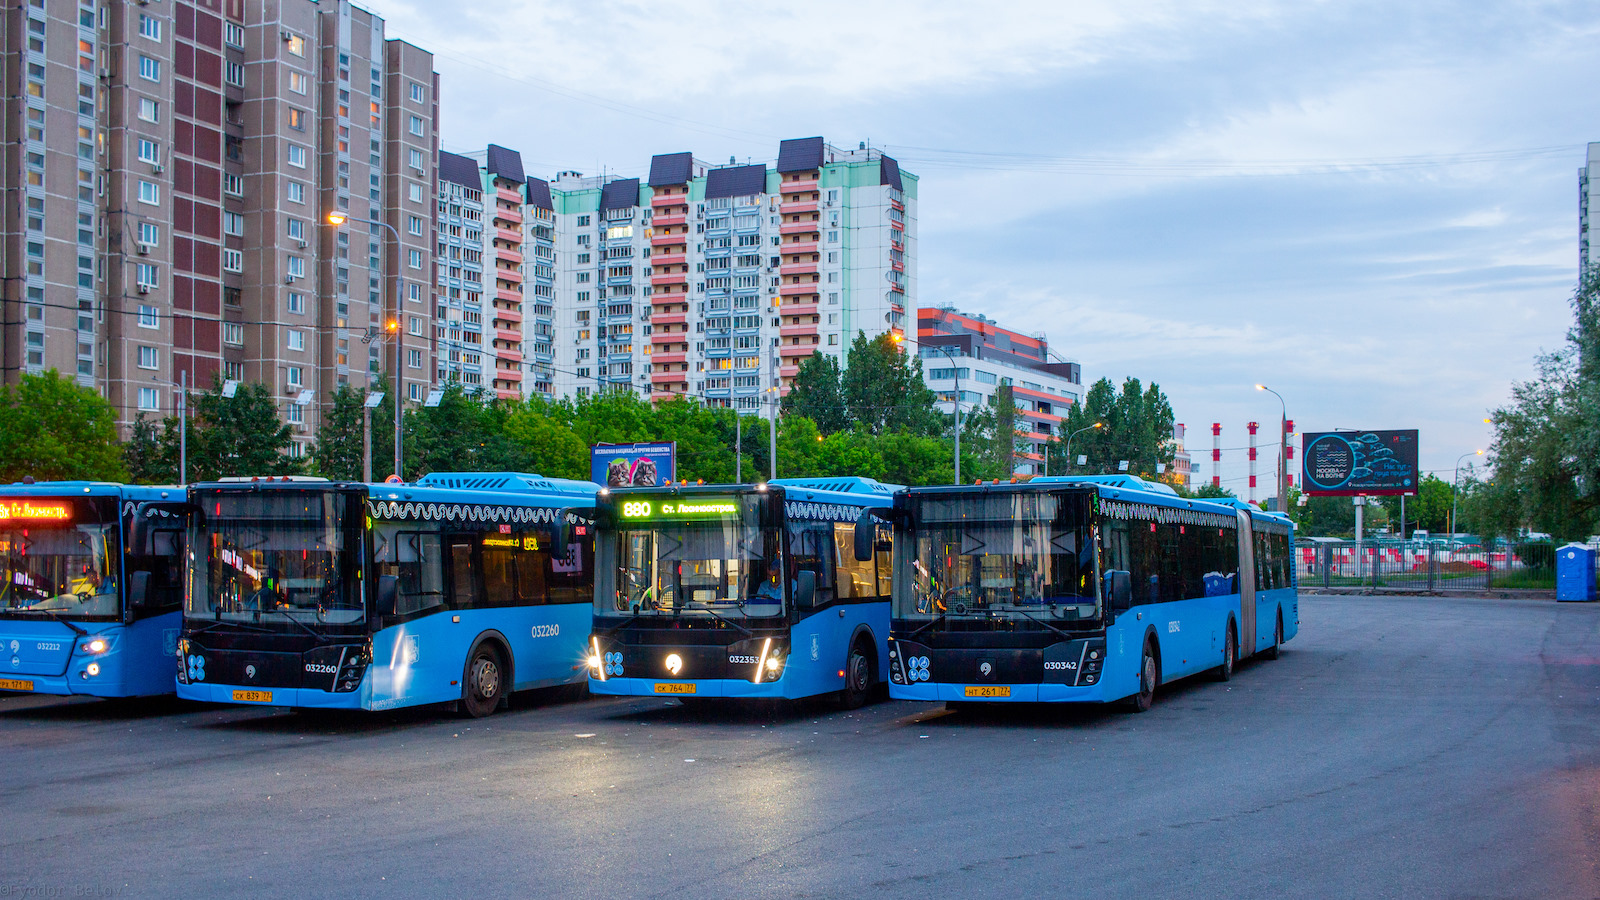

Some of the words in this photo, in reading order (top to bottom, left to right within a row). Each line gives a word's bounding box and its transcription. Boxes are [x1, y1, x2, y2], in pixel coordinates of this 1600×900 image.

[623, 502, 651, 517] 880
[662, 504, 676, 513] Ст.
[531, 624, 560, 638] 032260
[37, 642, 60, 651] 032212
[729, 655, 760, 664] 032353
[305, 663, 337, 673] 032260
[1044, 661, 1077, 670] 030342
[669, 684, 683, 692] 764
[981, 687, 996, 696] 261
[246, 692, 260, 700] 839
